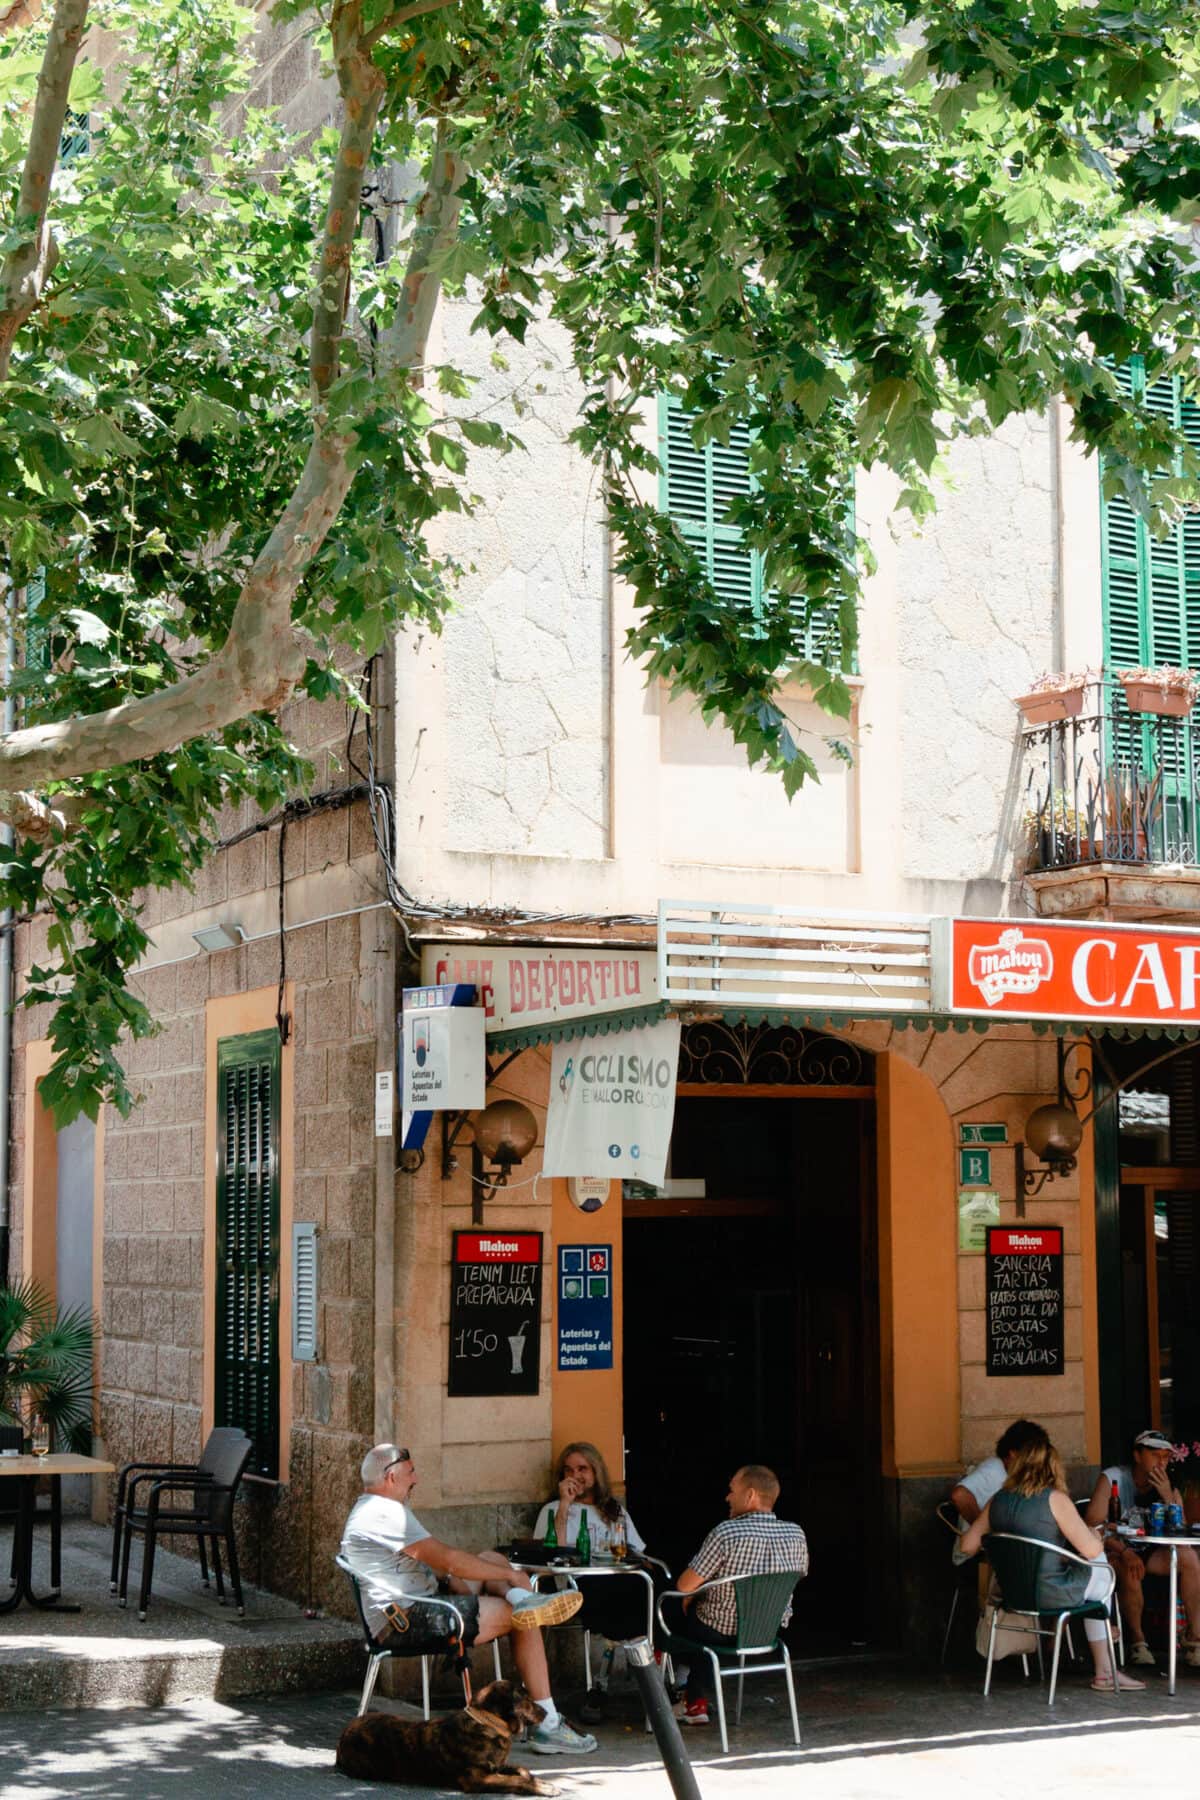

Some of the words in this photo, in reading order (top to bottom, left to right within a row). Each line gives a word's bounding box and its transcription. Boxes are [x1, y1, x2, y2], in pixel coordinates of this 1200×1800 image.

[580, 1055, 671, 1089] CICLISMO
[969, 1157, 983, 1178] B
[459, 1264, 503, 1284] TENIM
[510, 1265, 539, 1284] LLET
[994, 1271, 1048, 1288] TARTAS
[991, 1306, 1017, 1320] PLATO
[991, 1320, 1049, 1335] BOCATAS
[560, 1343, 597, 1354] Apuestas
[599, 1342, 611, 1351] del
[992, 1335, 1033, 1350] TAPAS
[561, 1356, 588, 1366] Estado
